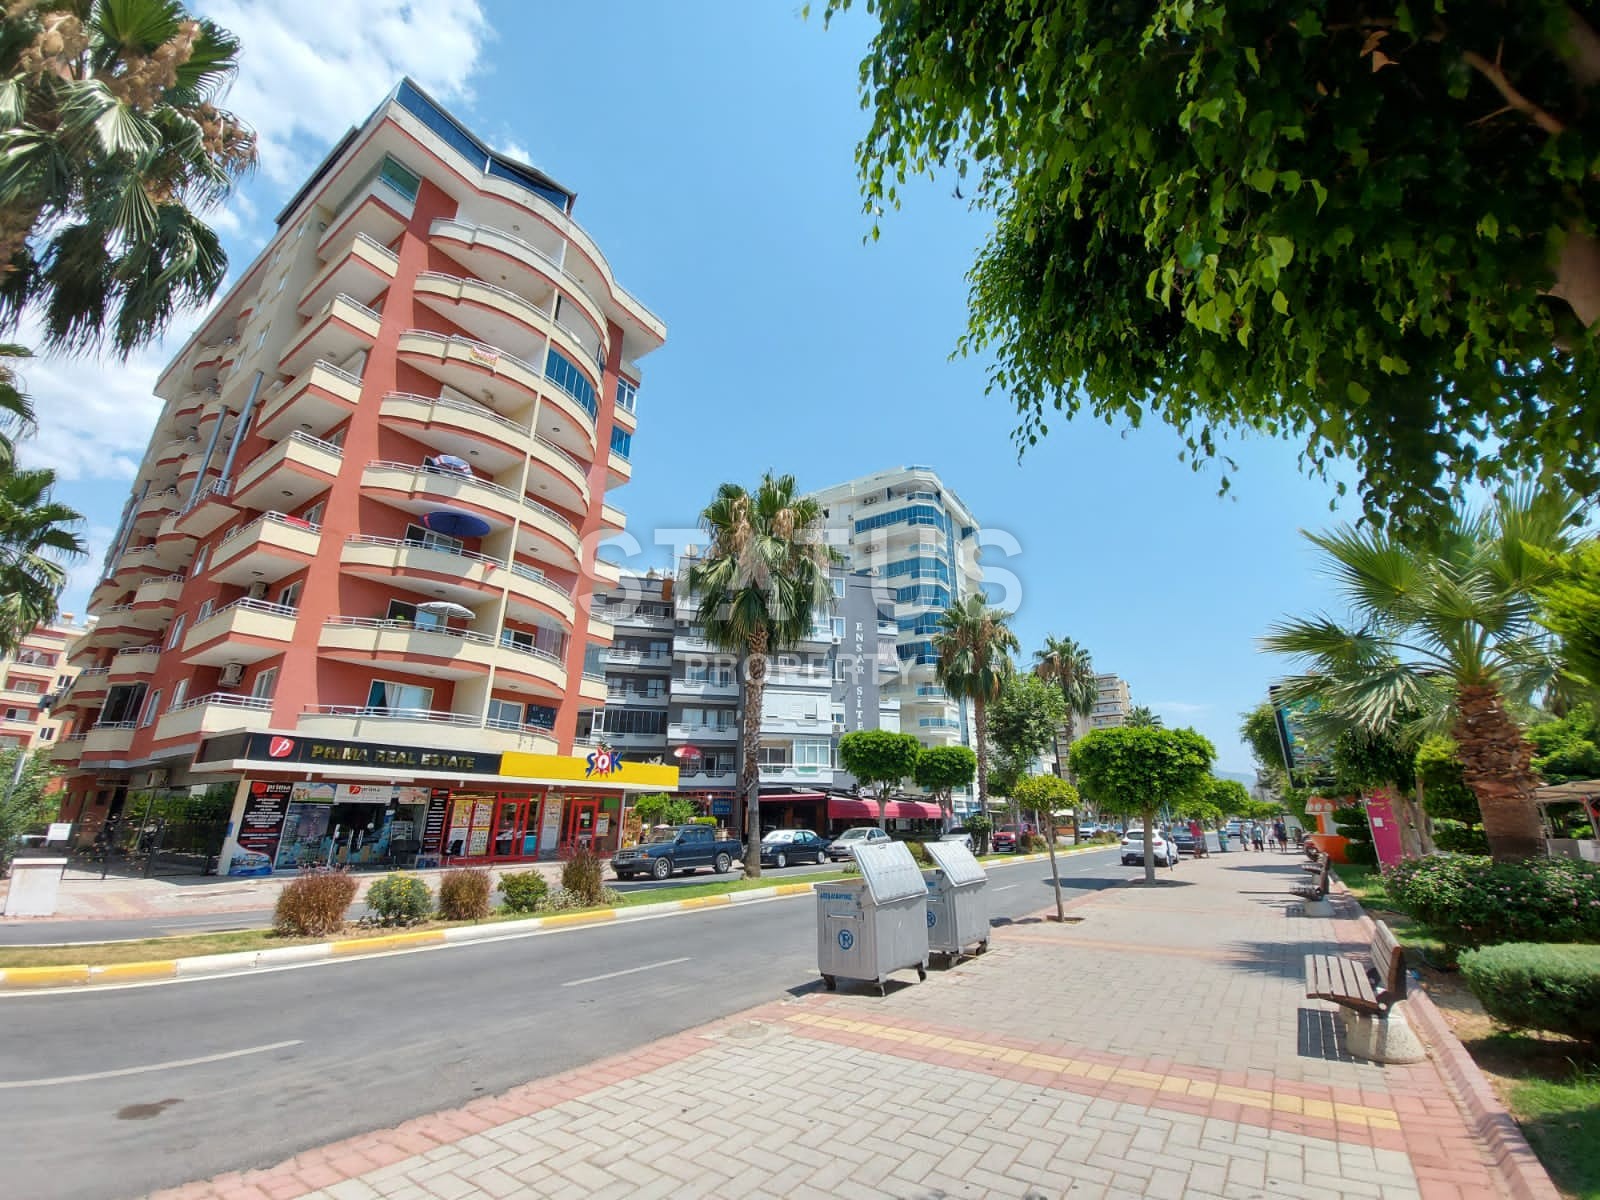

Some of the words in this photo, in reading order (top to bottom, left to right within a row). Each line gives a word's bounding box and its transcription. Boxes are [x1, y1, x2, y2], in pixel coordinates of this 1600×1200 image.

[855, 621, 865, 675] ENSAR
[374, 749, 417, 765] REAL
[420, 752, 476, 769] ESTATE
